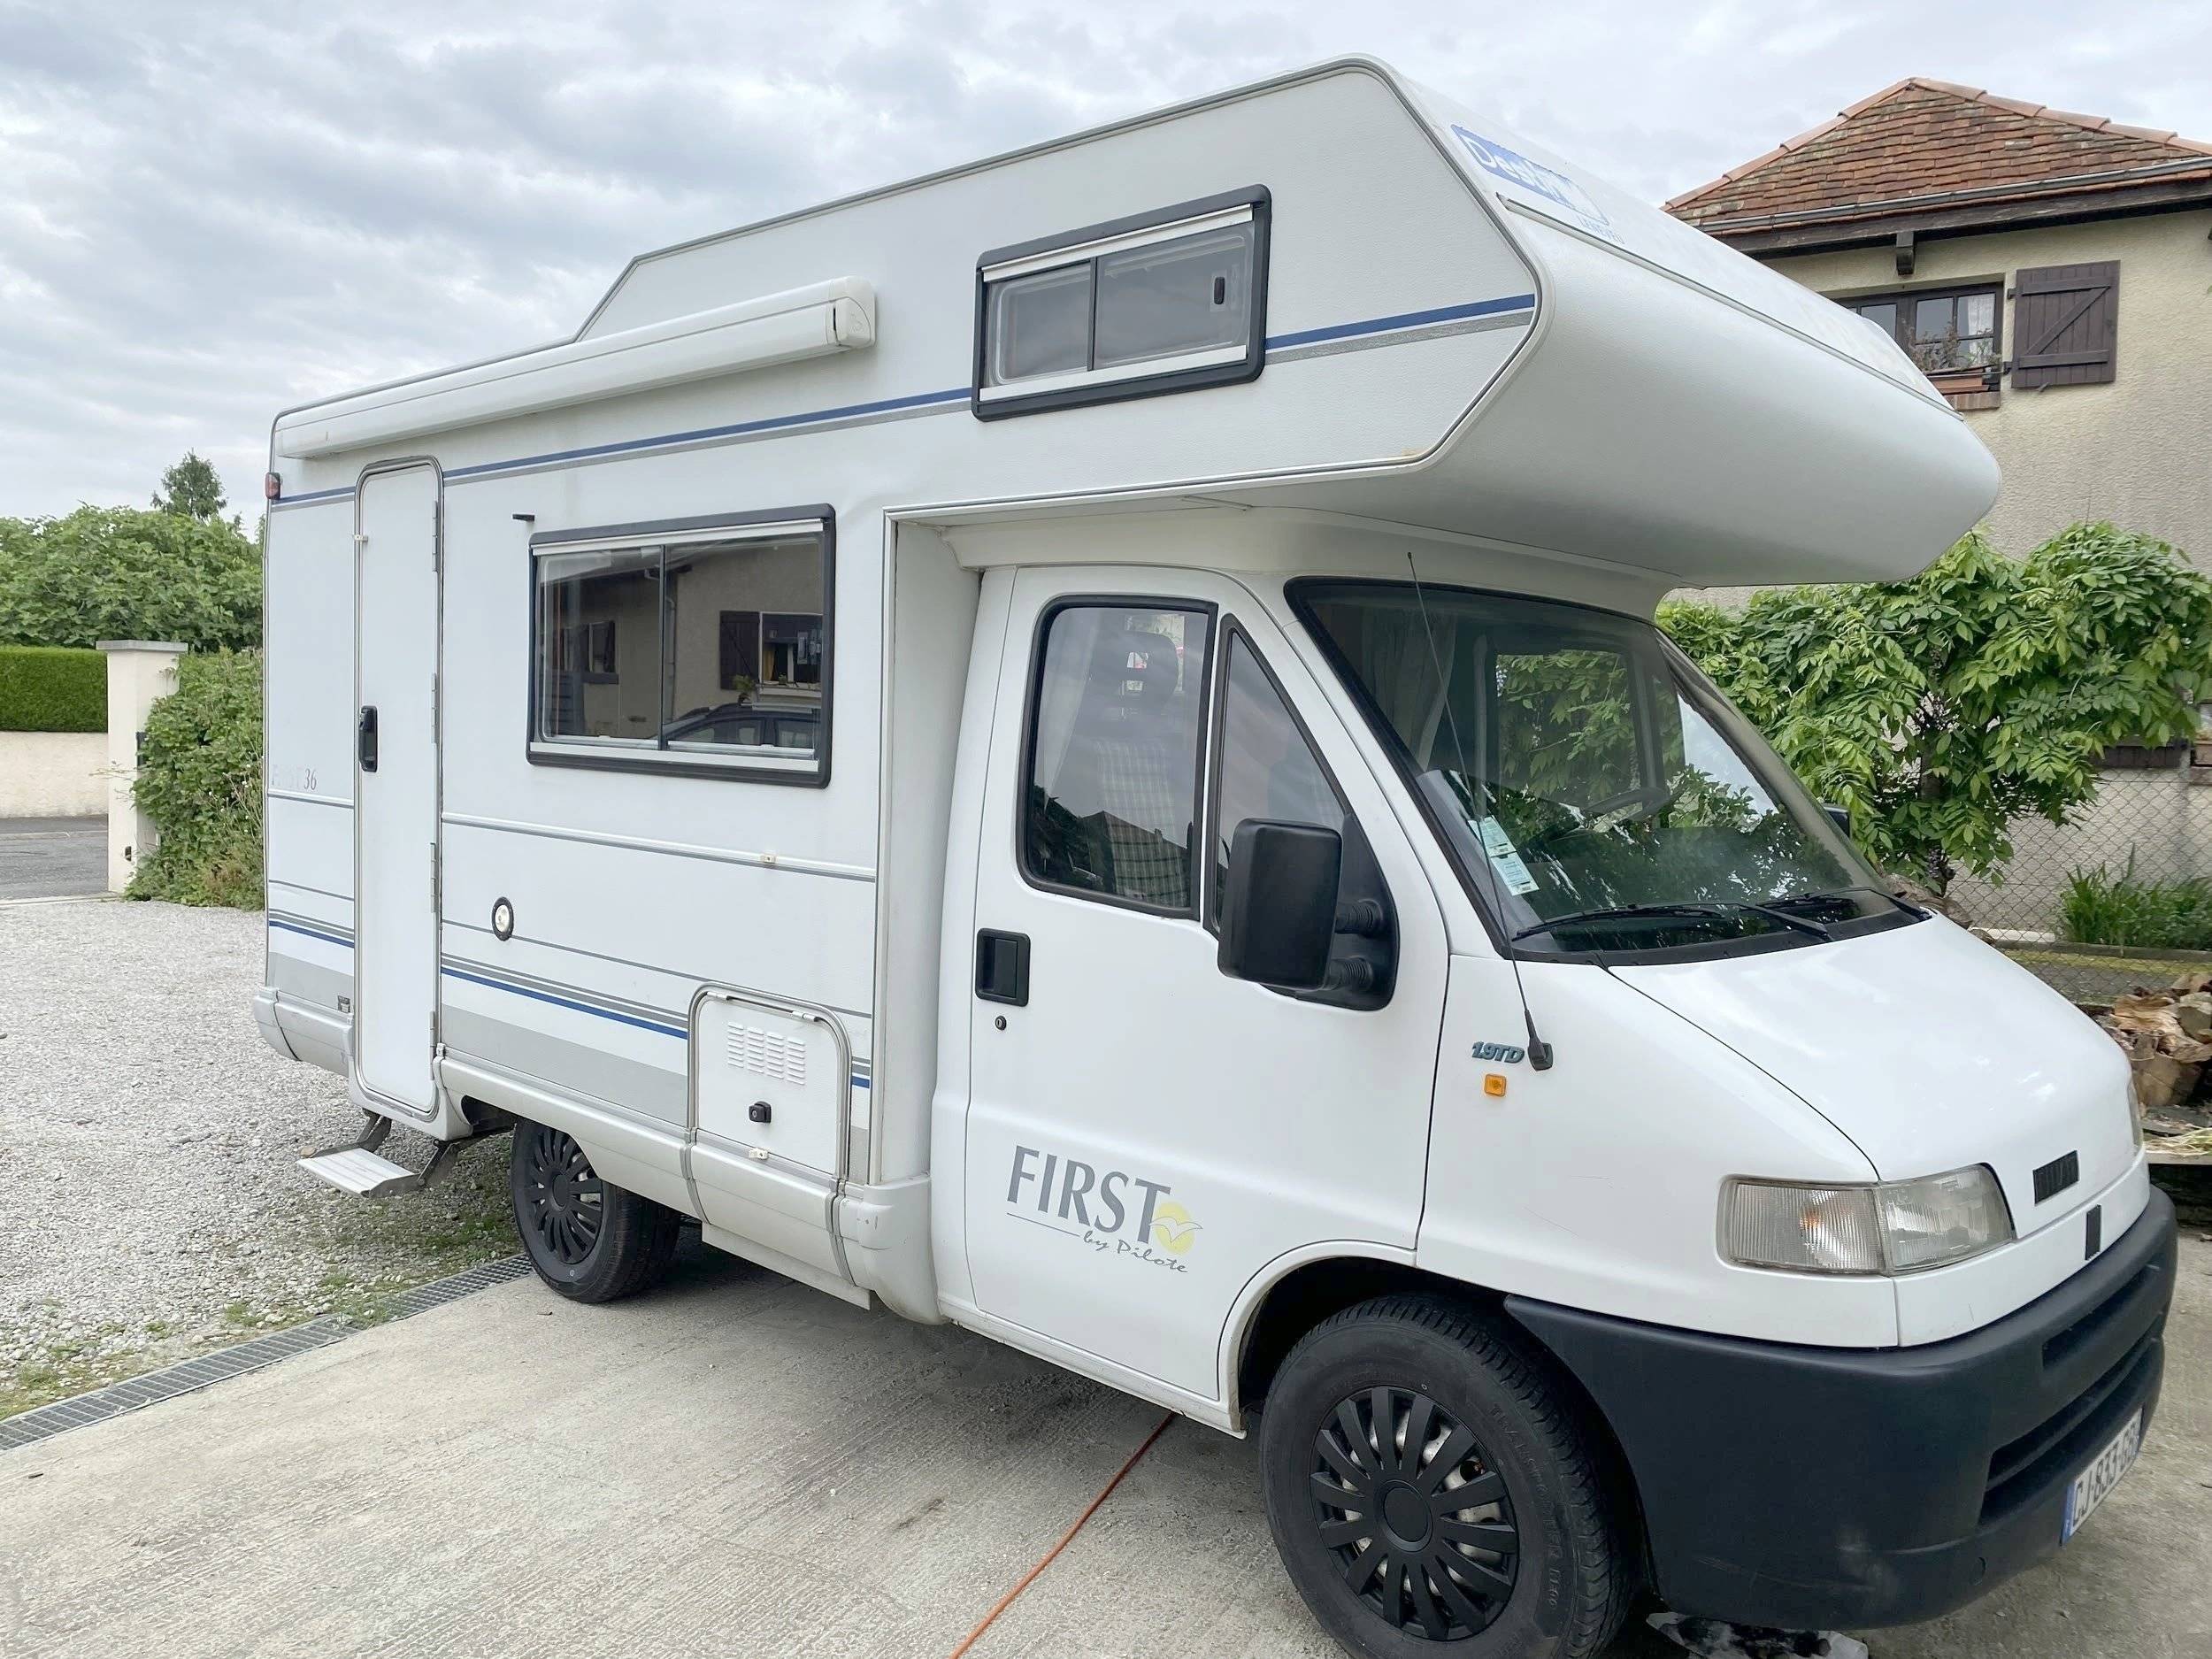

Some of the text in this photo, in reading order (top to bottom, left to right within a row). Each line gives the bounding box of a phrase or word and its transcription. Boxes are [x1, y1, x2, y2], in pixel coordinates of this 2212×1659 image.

[303, 767, 317, 790] 36
[1007, 1145, 1171, 1244] FIRST
[1083, 1231, 1187, 1273] by Pilote
